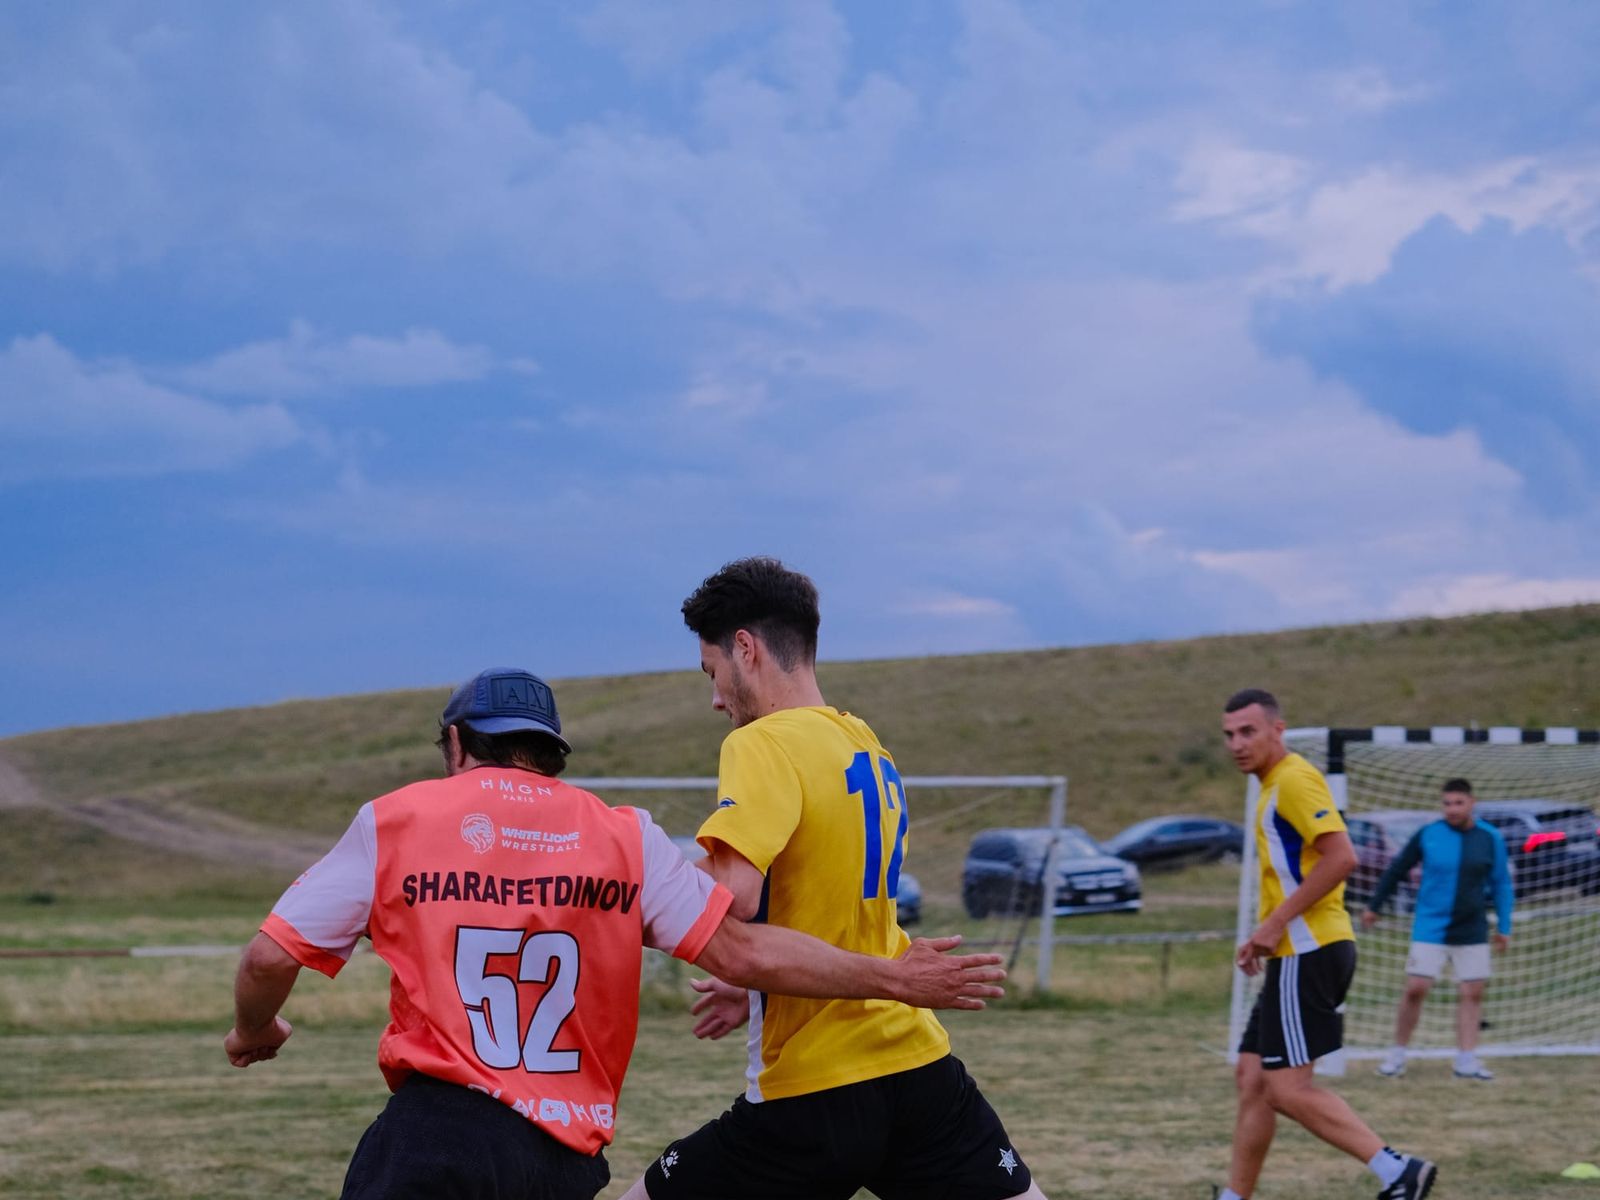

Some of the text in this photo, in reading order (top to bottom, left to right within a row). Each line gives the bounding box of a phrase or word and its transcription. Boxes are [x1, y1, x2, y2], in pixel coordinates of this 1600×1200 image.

[480, 779, 552, 796] HMGN
[501, 827, 580, 844] WHITE LIONS
[501, 840, 581, 853] WRESTBALL
[402, 871, 639, 915] SHARAFETDINOV
[453, 924, 581, 1074] 52
